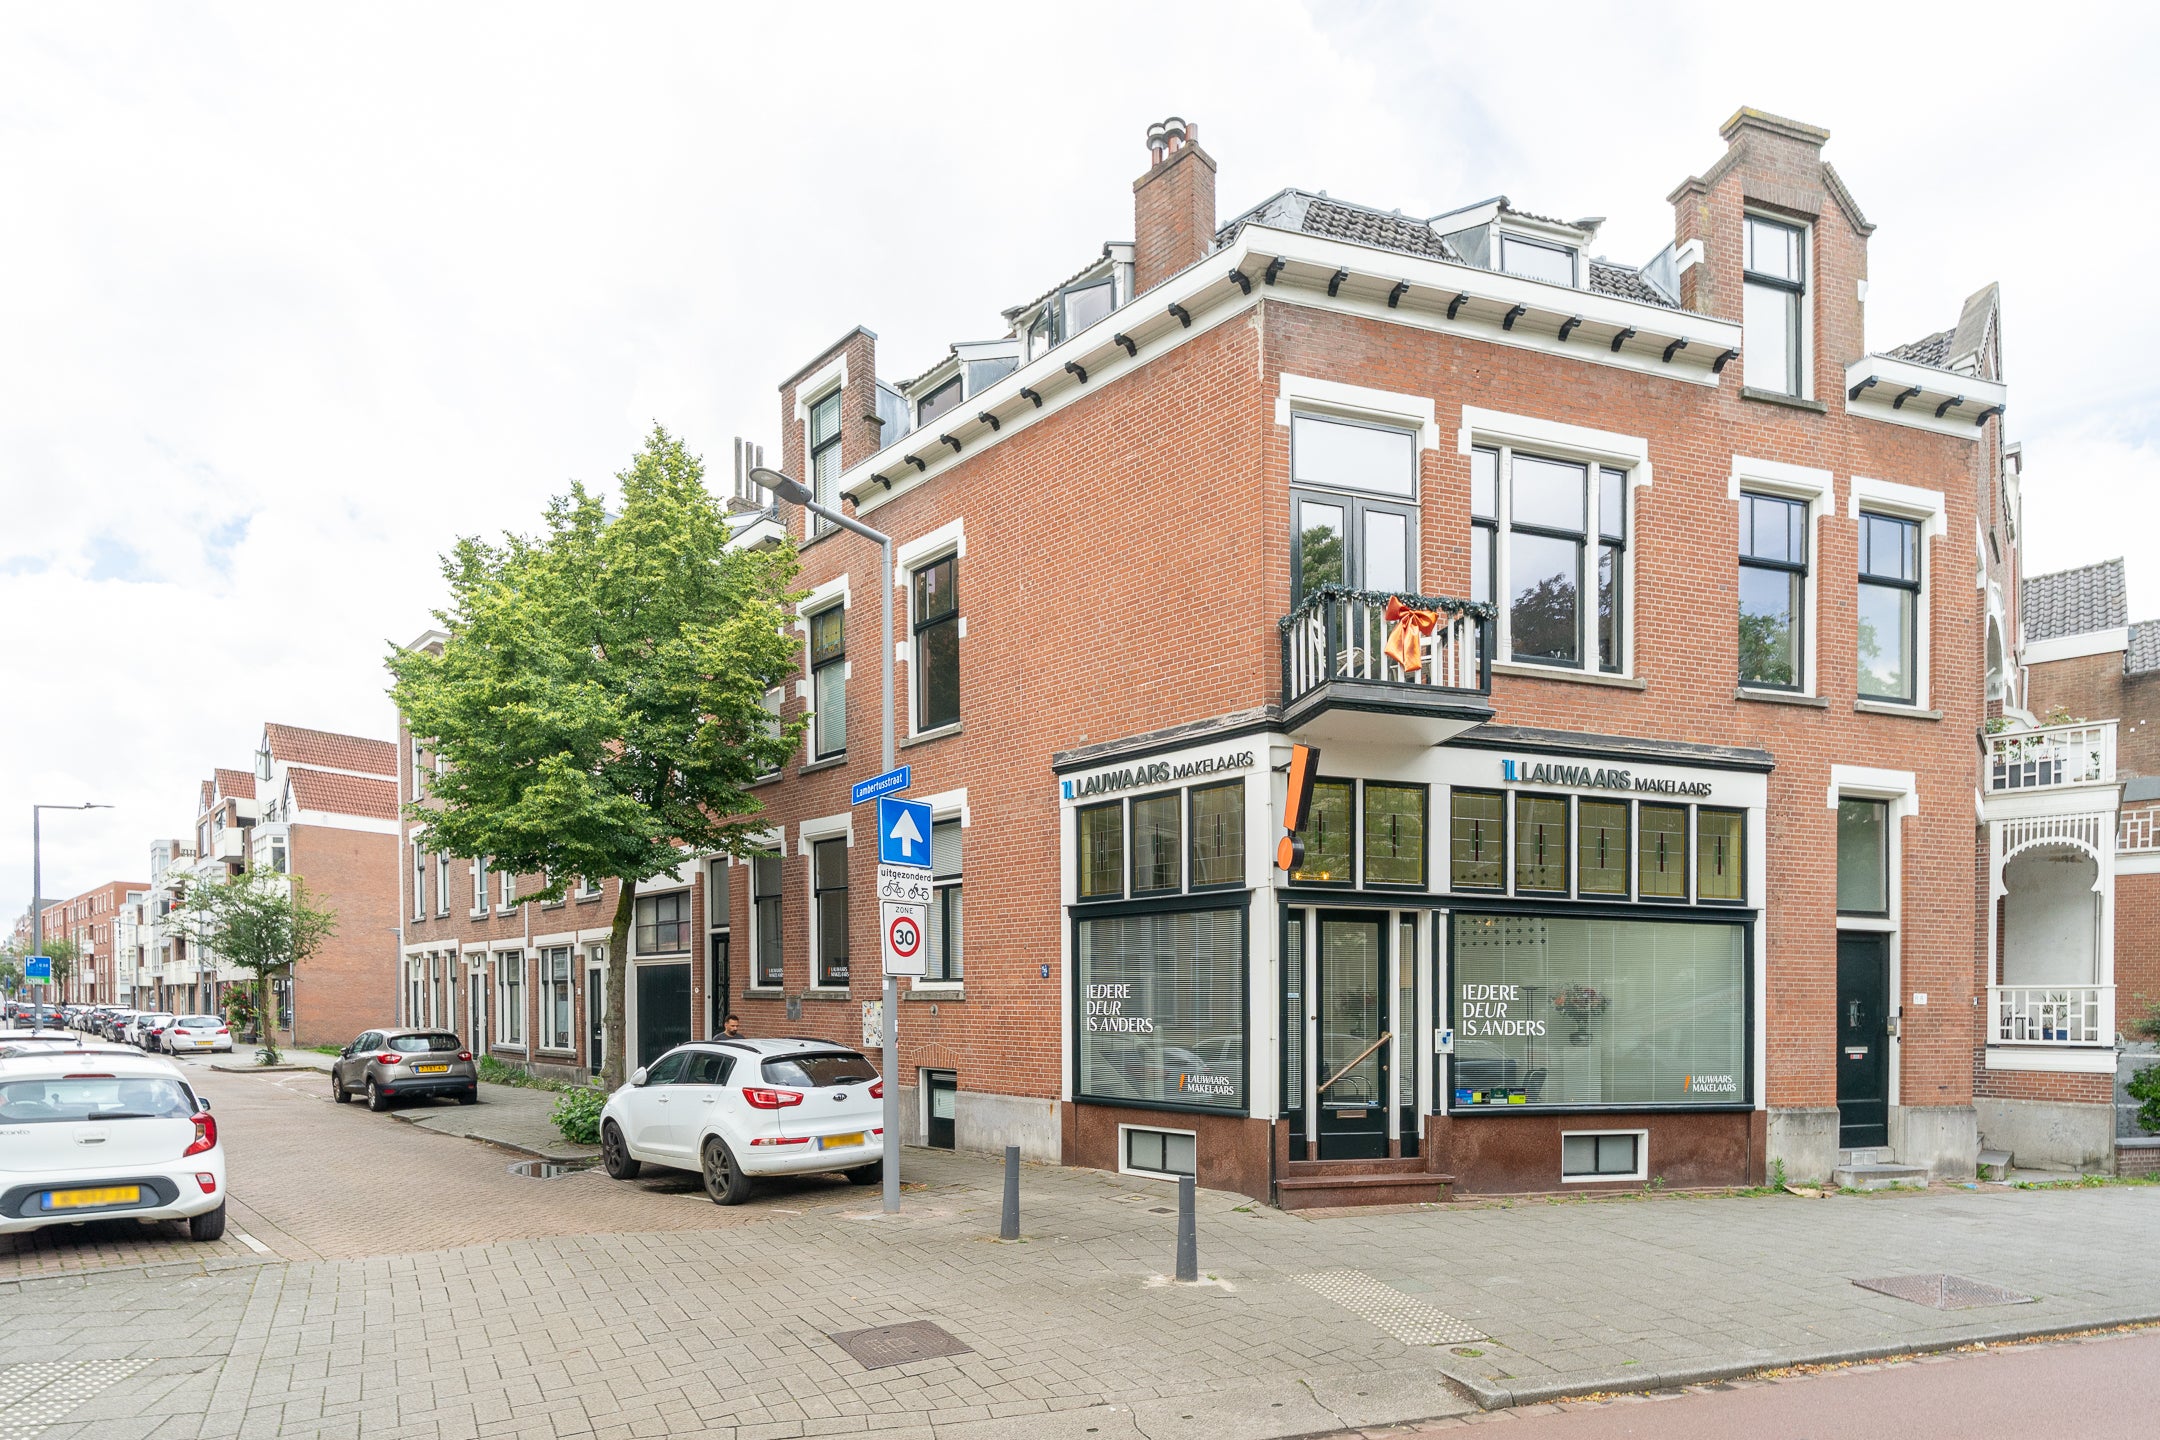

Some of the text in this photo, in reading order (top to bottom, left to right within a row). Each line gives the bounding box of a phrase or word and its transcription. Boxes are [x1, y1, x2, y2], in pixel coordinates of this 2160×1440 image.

[1076, 762, 1170, 796] LAUWAARS
[1173, 751, 1255, 779] MAKELAARS
[1522, 761, 1632, 790] LAUWAARS
[1635, 777, 1712, 796] MAKELAARS
[856, 772, 903, 798] Lambertusstraat
[880, 868, 932, 882] uitgezonderd
[895, 906, 914, 915] ZONE
[895, 929, 915, 946] 30
[27, 957, 37, 968] P
[1086, 984, 1131, 999] IEDERE
[1462, 984, 1520, 1001] IEDERE
[1086, 1000, 1122, 1016] DEUR
[1462, 1002, 1508, 1018] DEUR
[1086, 1016, 1154, 1033] IS ANDERS
[1462, 1019, 1546, 1036] IS ANDERS
[1187, 1074, 1230, 1086] LAUWAARS
[1692, 1074, 1733, 1084] LAUWAARS
[1187, 1083, 1235, 1096] MAKELAARS
[1692, 1083, 1737, 1093] MAKELAARS
